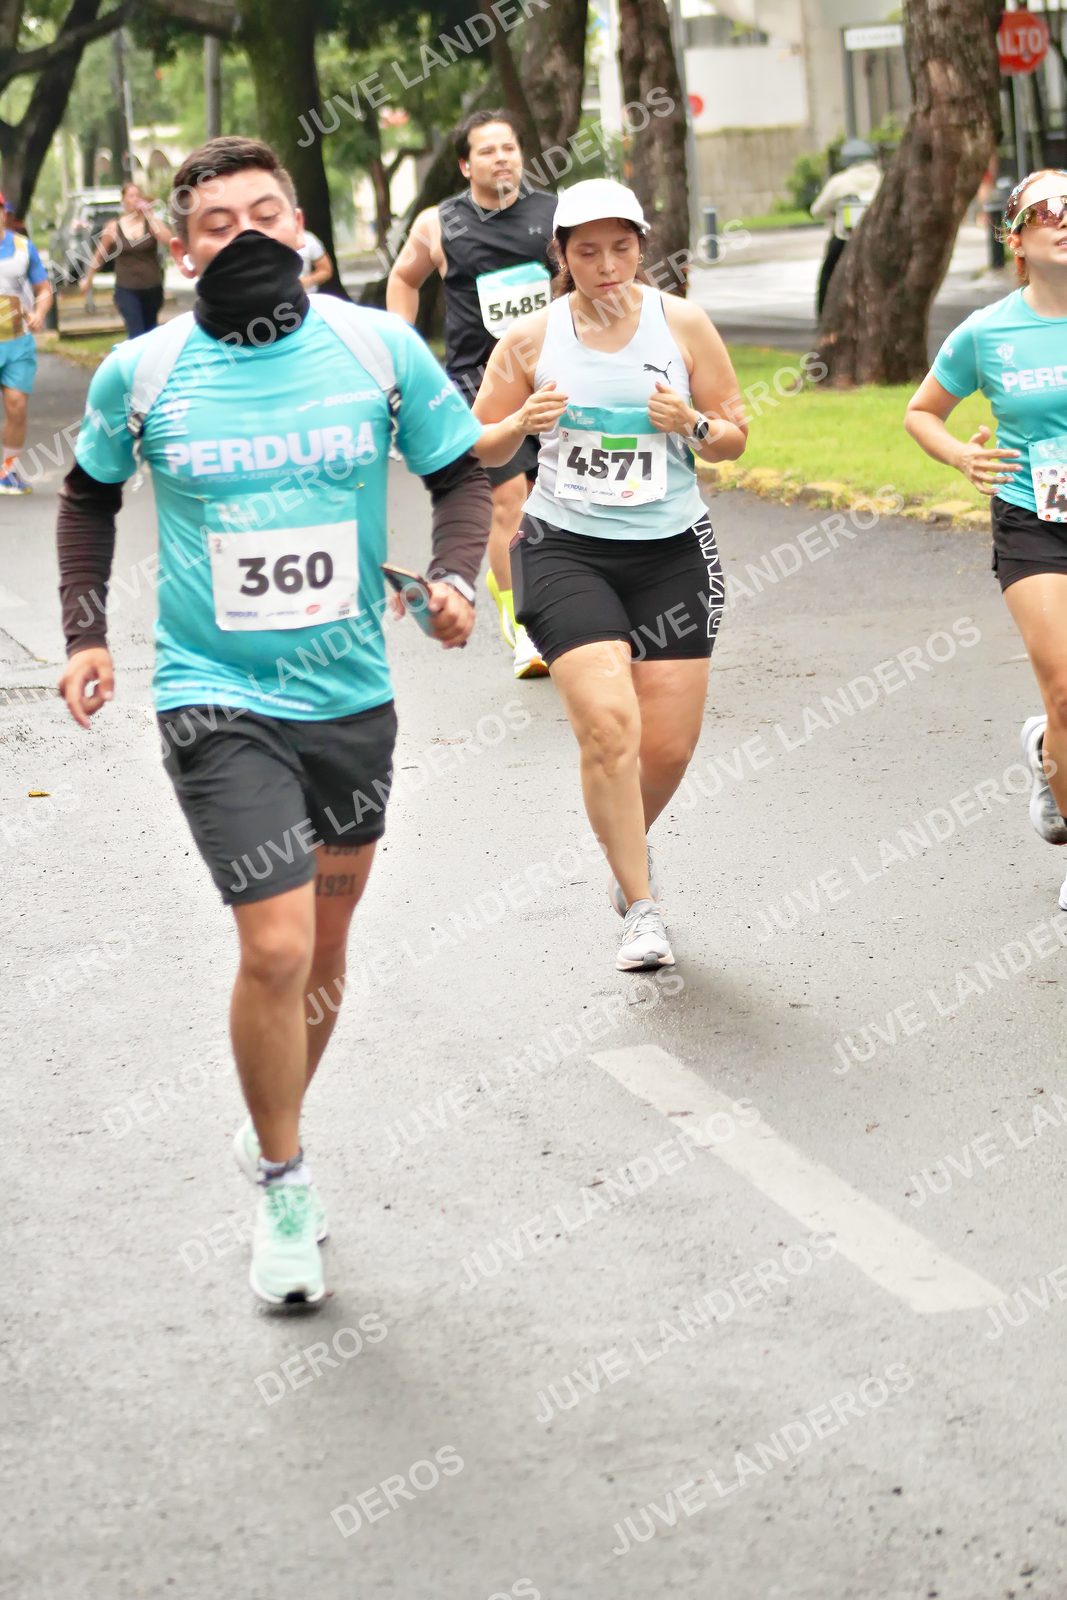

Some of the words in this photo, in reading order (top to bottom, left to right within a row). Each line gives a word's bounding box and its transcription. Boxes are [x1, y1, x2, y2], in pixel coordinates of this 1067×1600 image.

[488, 293, 547, 321] 5485
[164, 421, 375, 477] PERDURA
[567, 446, 653, 481] 4571
[238, 551, 333, 597] 360
